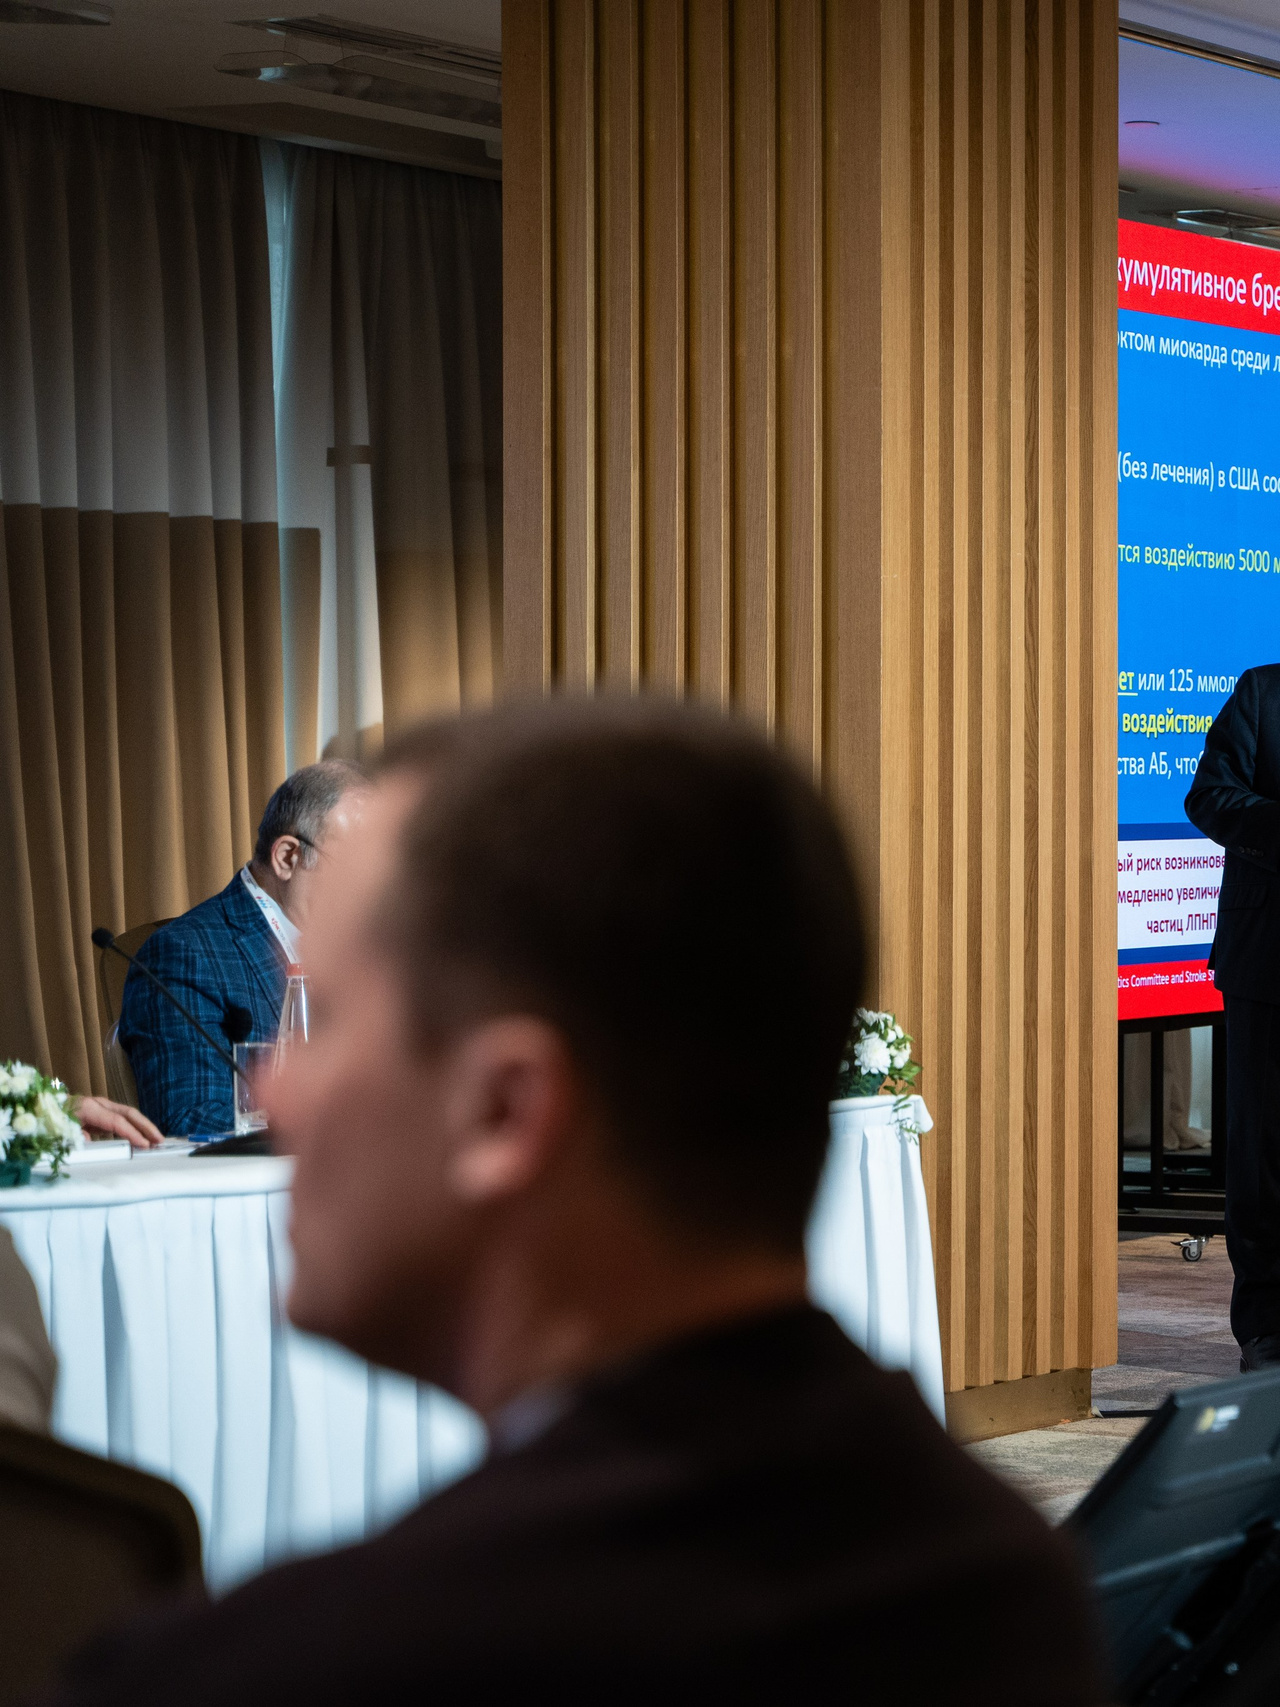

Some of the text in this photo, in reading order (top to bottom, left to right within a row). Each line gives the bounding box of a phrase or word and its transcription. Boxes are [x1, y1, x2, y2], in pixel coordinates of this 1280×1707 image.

[1118, 331, 1156, 352] ктом
[1160, 337, 1228, 368] миокарда
[1231, 347, 1271, 375] среди
[1117, 451, 1148, 482] (без
[1151, 461, 1214, 492] лечения)
[1218, 470, 1226, 487] в
[1229, 466, 1260, 492] США
[1118, 543, 1140, 563] тся
[1144, 543, 1235, 571] воздействию
[1238, 548, 1271, 573] 5000
[1138, 673, 1165, 692] или
[1169, 668, 1194, 692] 125
[1122, 707, 1213, 739] воздействия
[1117, 757, 1145, 775] ства
[1148, 751, 1172, 780] АБ,
[1136, 858, 1163, 876] риск
[1118, 888, 1174, 907] медленно
[1146, 912, 1217, 936] частиц ЛПНП
[1131, 973, 1169, 987] Committee
[1171, 970, 1184, 985] and
[1185, 969, 1208, 982] Stroke
